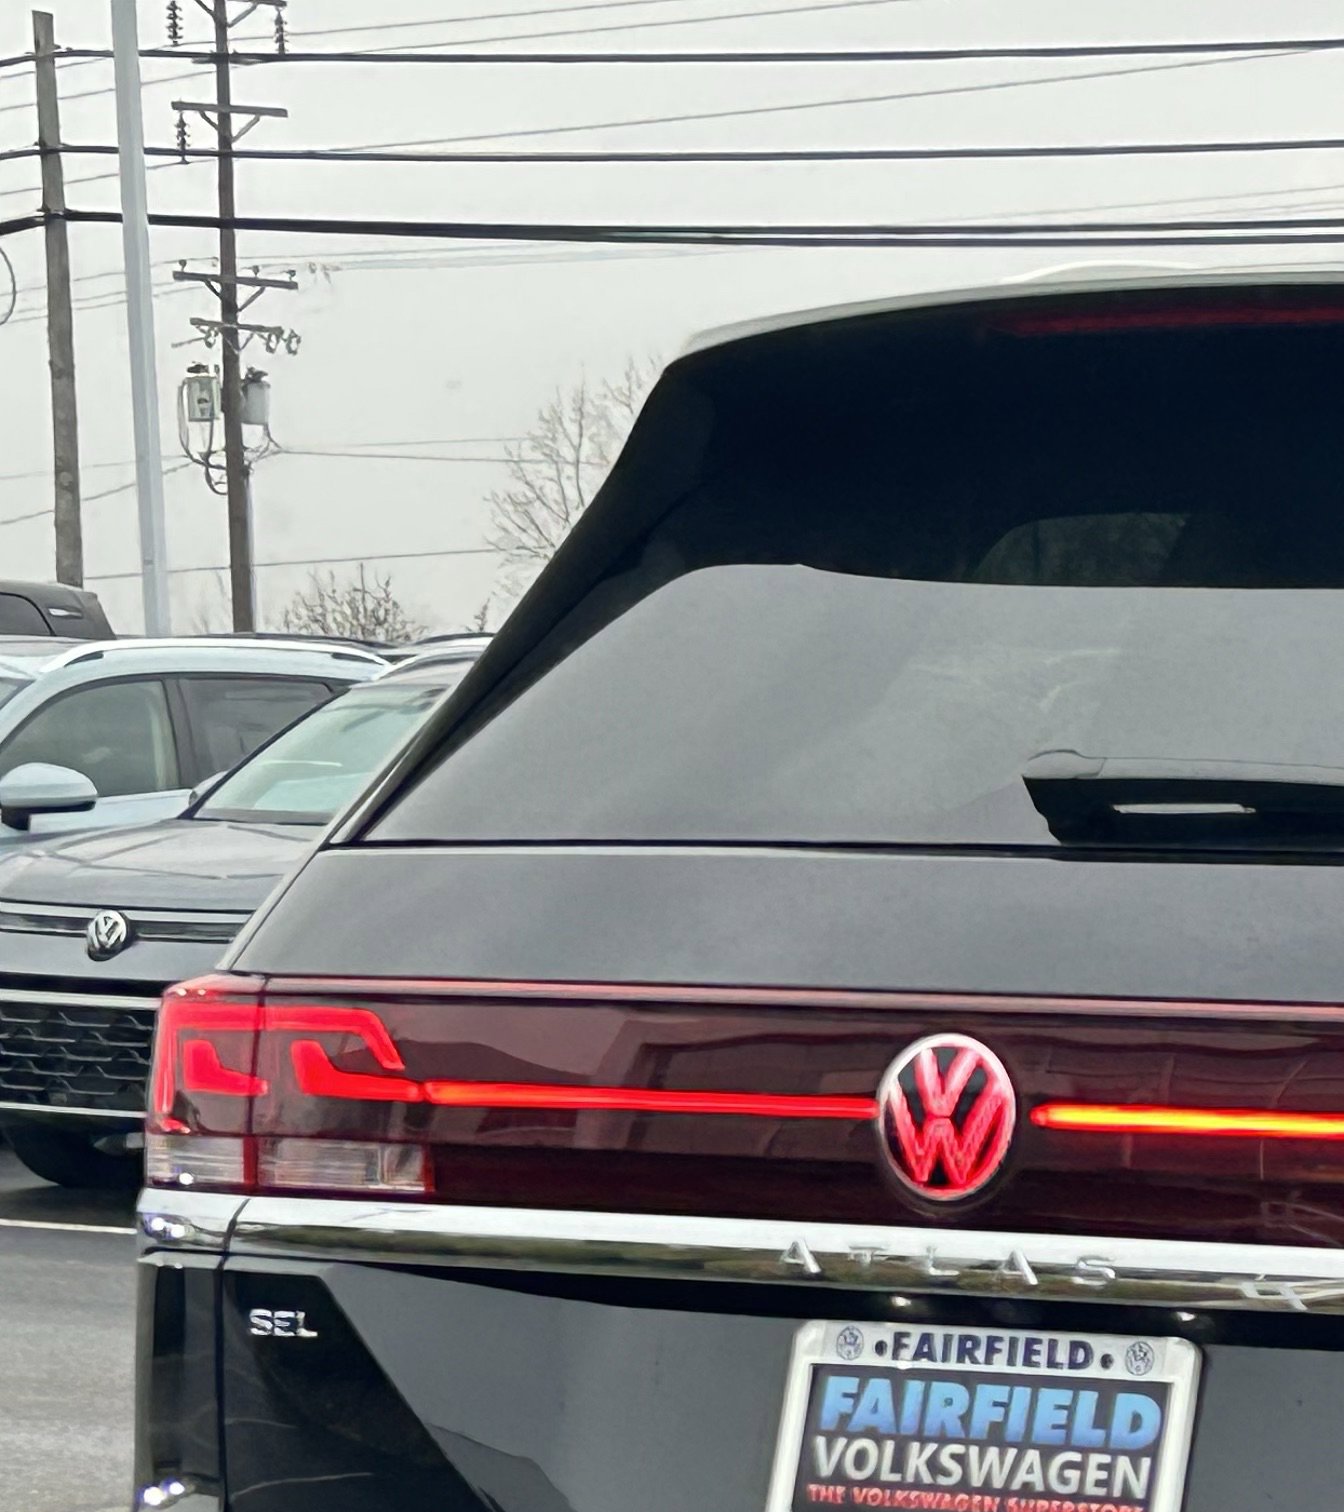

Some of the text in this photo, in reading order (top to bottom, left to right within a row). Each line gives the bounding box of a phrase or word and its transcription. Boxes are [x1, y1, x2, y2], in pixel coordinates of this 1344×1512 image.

[779, 1237, 1118, 1287] ATLAS
[248, 1308, 318, 1337] SEL
[890, 1331, 1094, 1371] FAIRFIELD
[818, 1375, 1162, 1450] FAIRFIELD
[812, 1435, 1151, 1499] VOLKSWAGEN
[807, 1484, 846, 1504] THE
